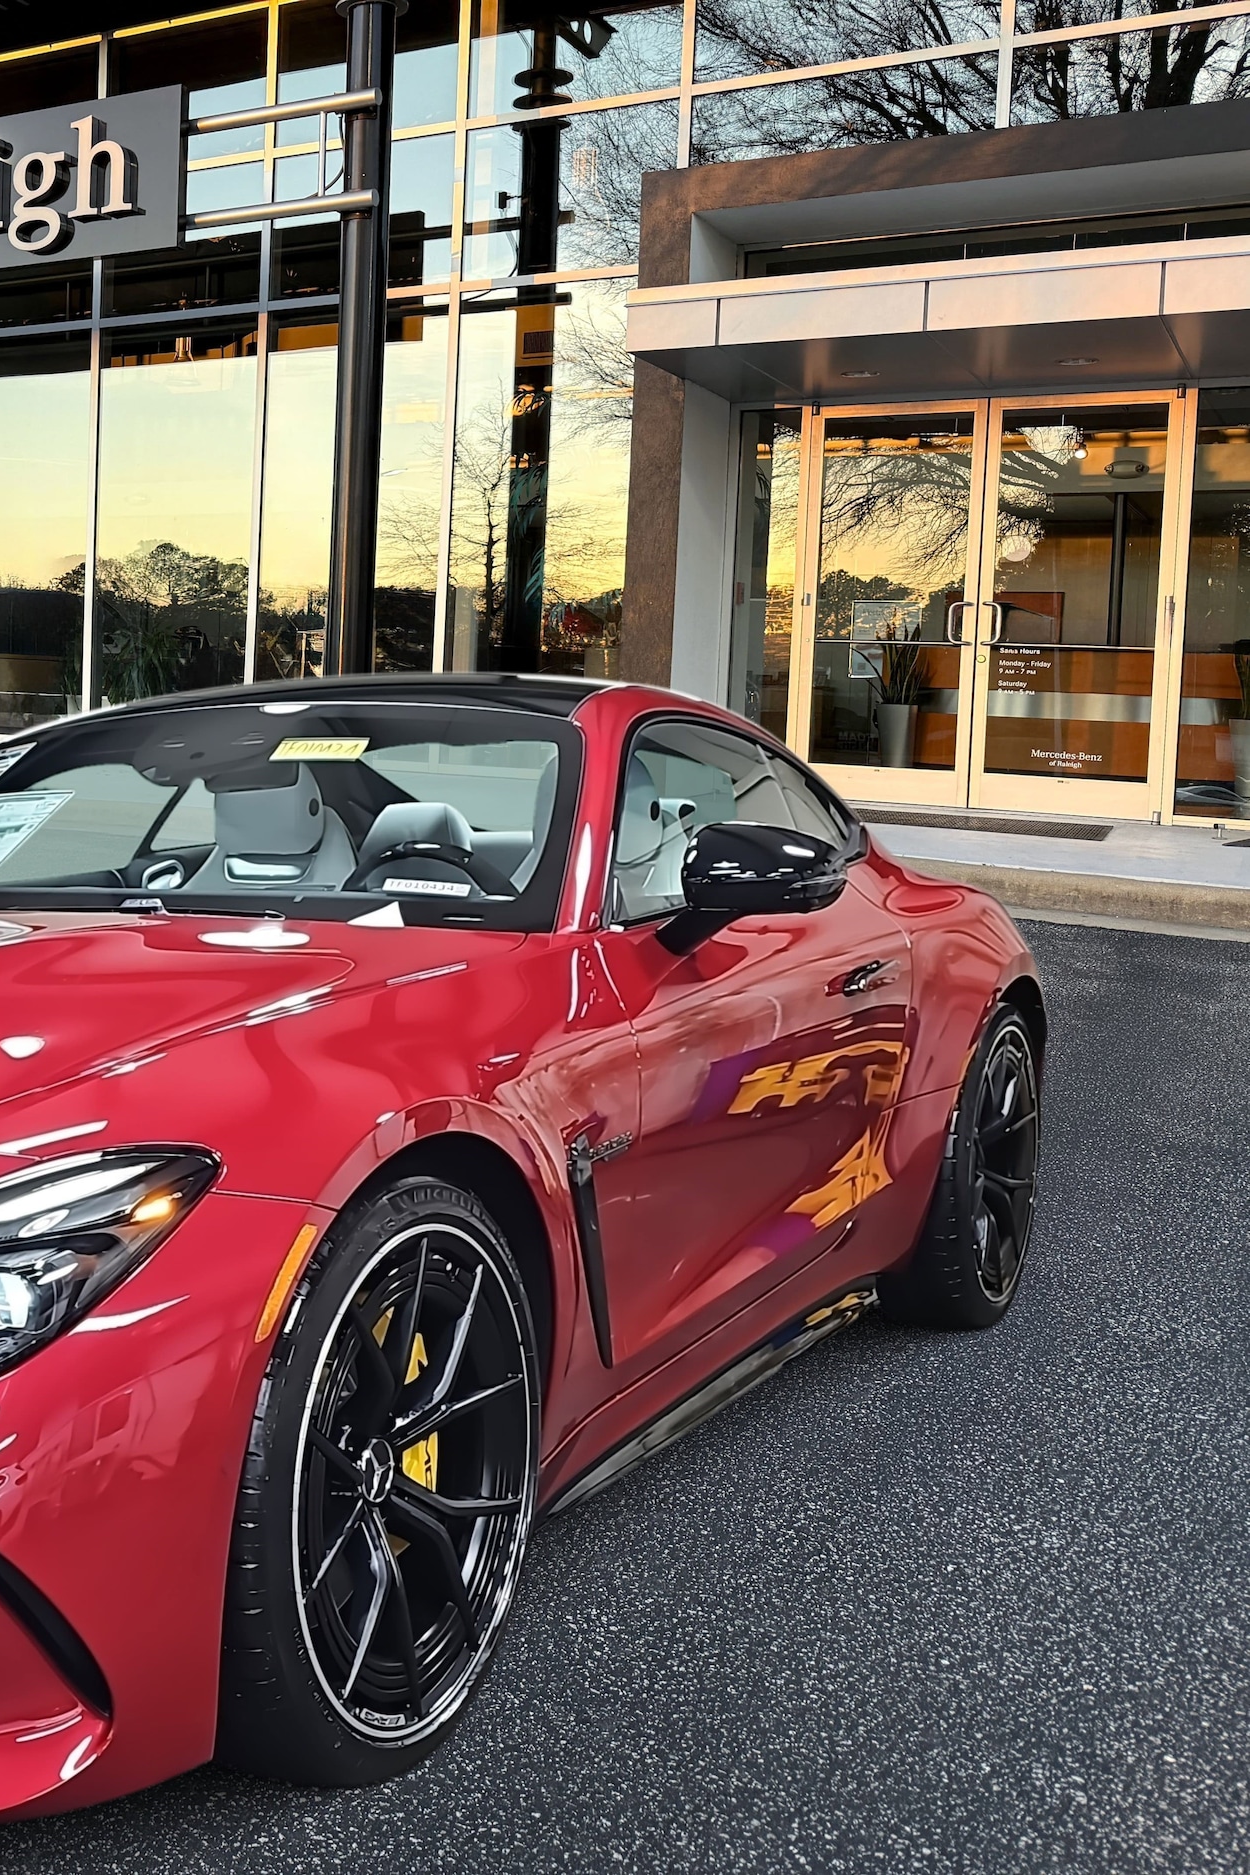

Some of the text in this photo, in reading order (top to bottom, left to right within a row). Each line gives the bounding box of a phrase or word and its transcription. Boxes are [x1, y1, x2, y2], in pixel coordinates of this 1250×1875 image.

[998, 660, 1026, 668] Monday
[1030, 660, 1052, 669] Friday
[997, 680, 1028, 689] Saturday
[1030, 749, 1103, 762] Mercedes-Benz
[1057, 760, 1083, 769] Raleigh
